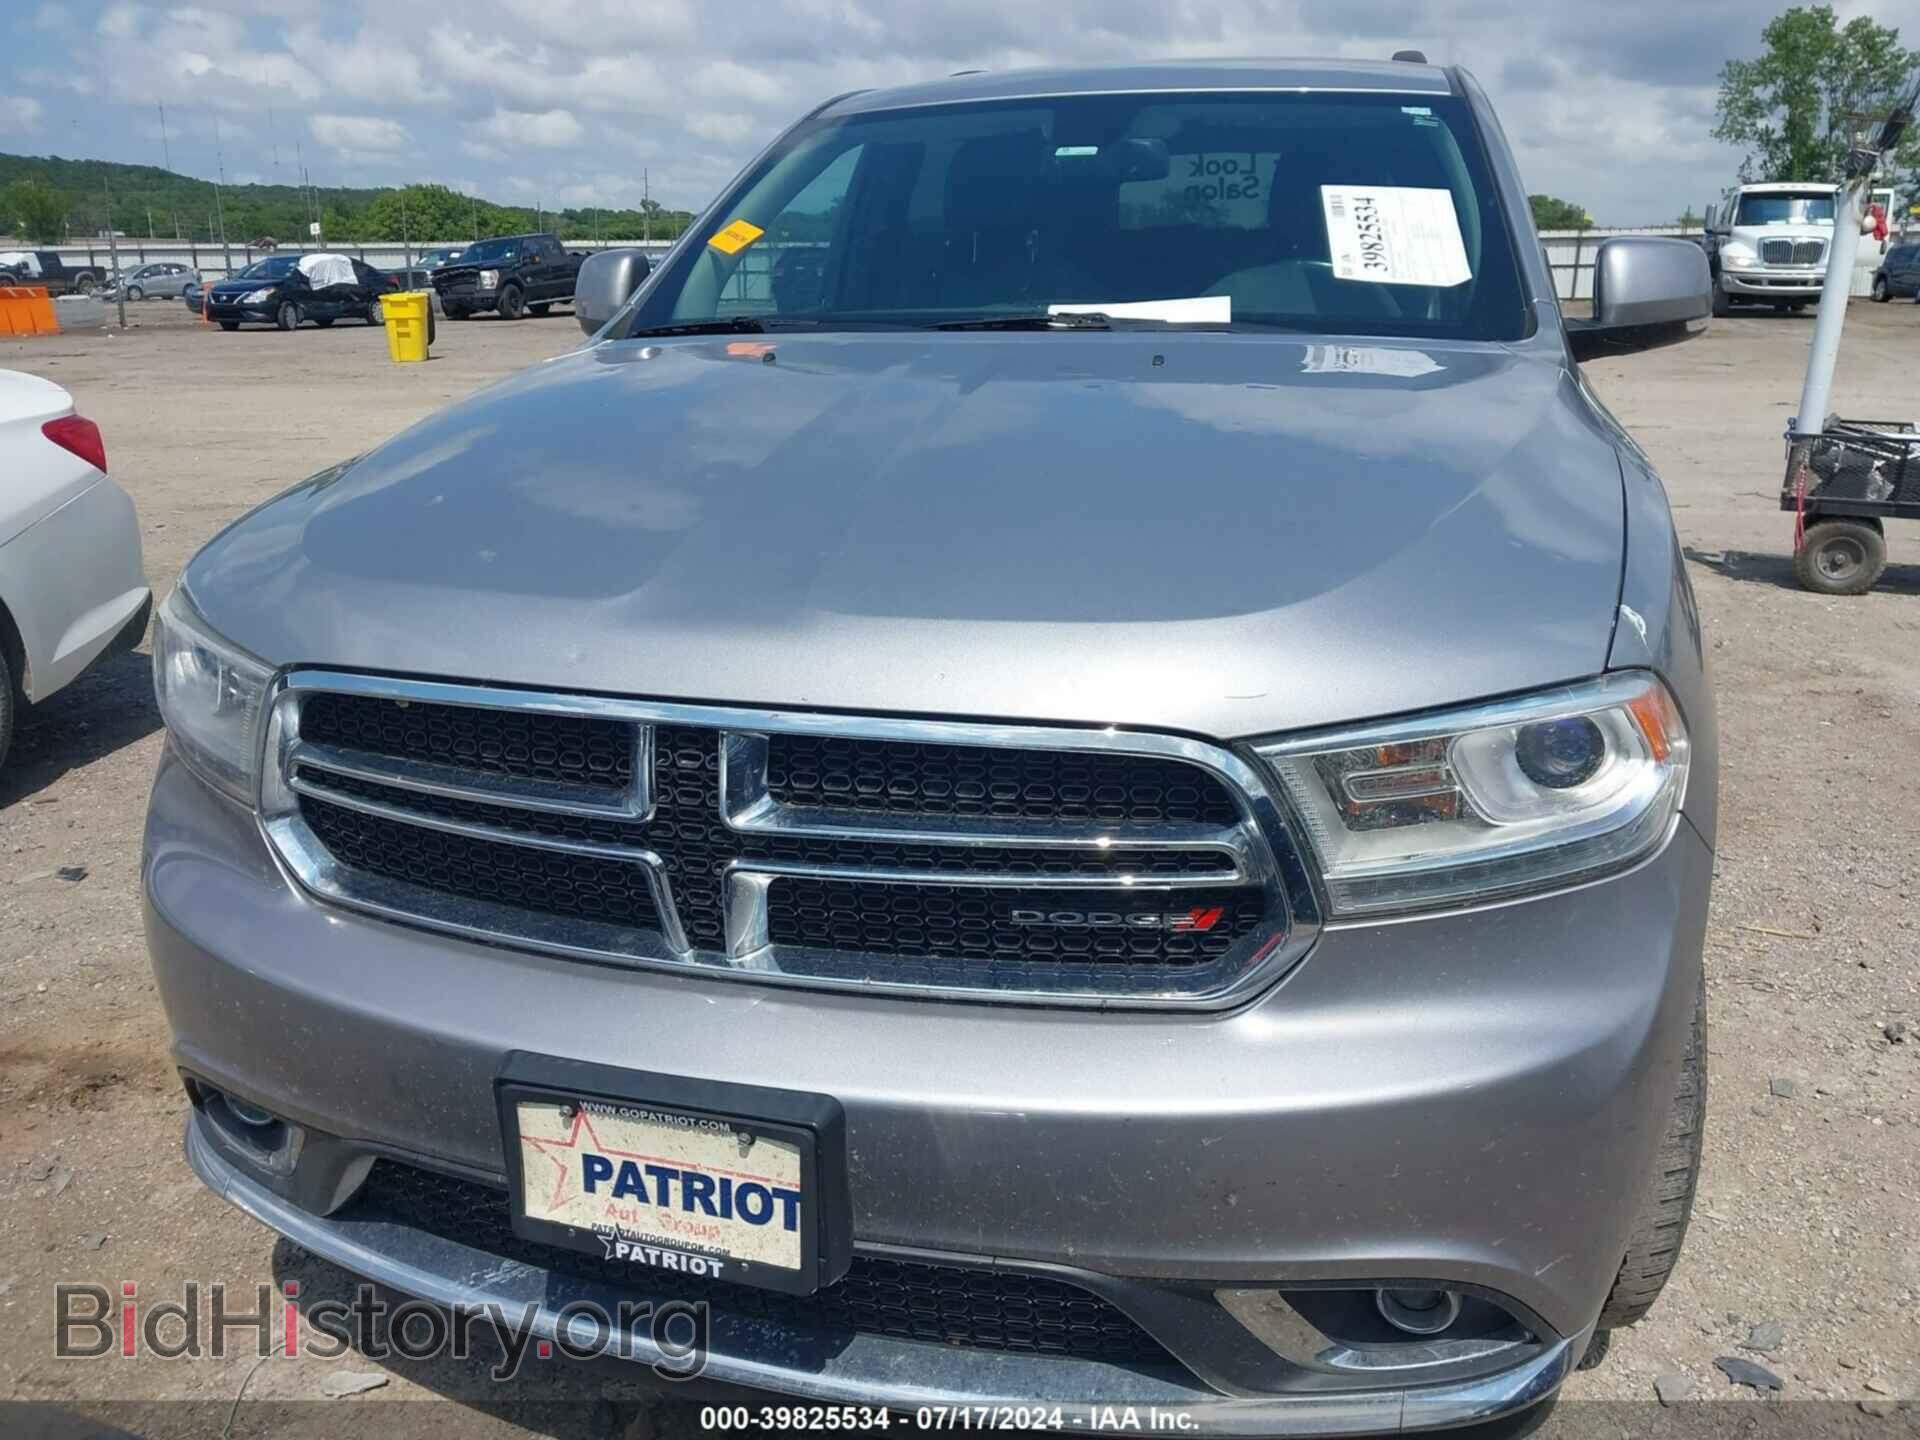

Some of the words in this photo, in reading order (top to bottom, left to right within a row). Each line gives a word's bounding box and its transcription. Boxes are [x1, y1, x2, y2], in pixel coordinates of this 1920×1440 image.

[1352, 196, 1388, 272] 39825534
[1011, 909, 1196, 928] DODGE
[579, 1101, 730, 1133] WWW.GOPATRIOT.COM
[581, 1152, 801, 1232] PATRIOT
[605, 1203, 640, 1225] Aut
[591, 1222, 731, 1257] PATROTAUTOGROUPOK.COM
[615, 1242, 724, 1278] PATRIOT
